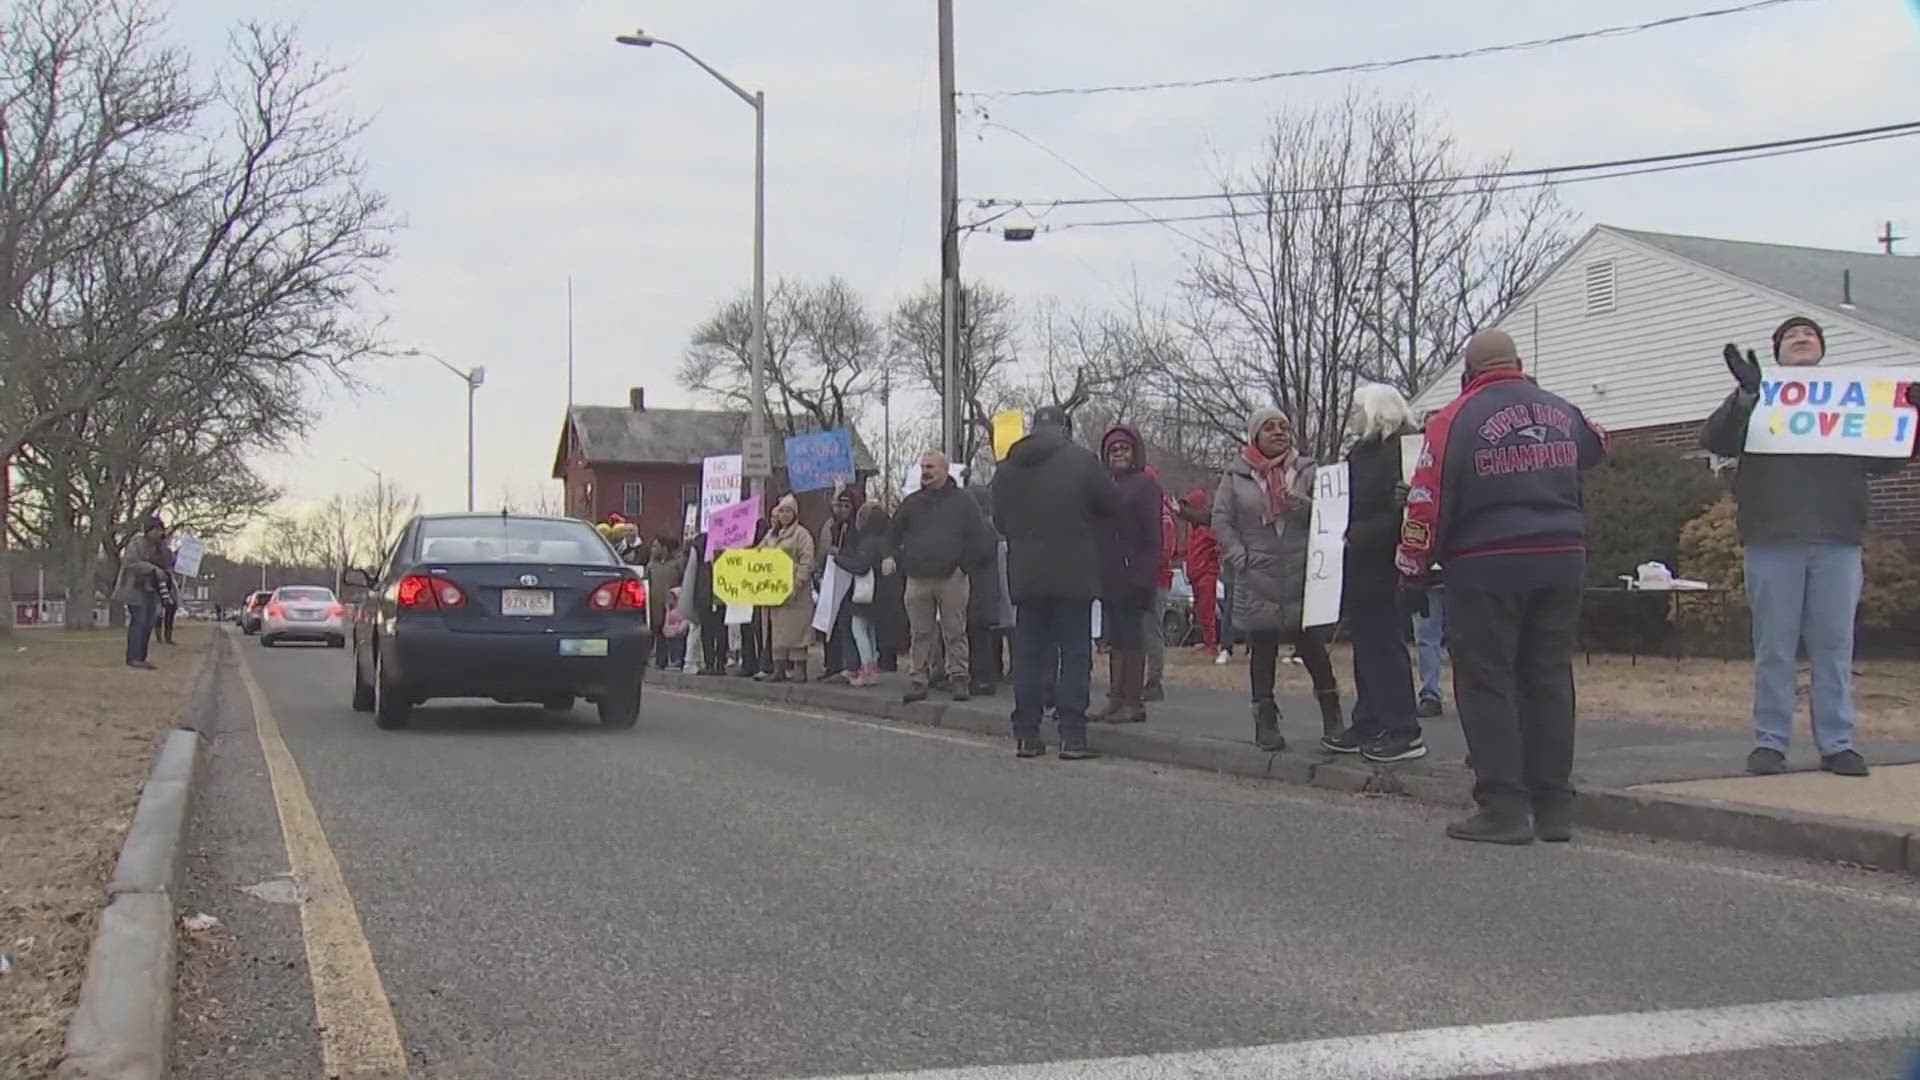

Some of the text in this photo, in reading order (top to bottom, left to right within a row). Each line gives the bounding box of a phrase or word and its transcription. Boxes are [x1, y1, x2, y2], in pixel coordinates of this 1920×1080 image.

[1761, 381, 1832, 407] YOU
[1478, 404, 1532, 445] SUPER
[1768, 411, 1909, 442] LOVED!
[726, 556, 773, 573] WE LOVE
[716, 575, 738, 597] OUR
